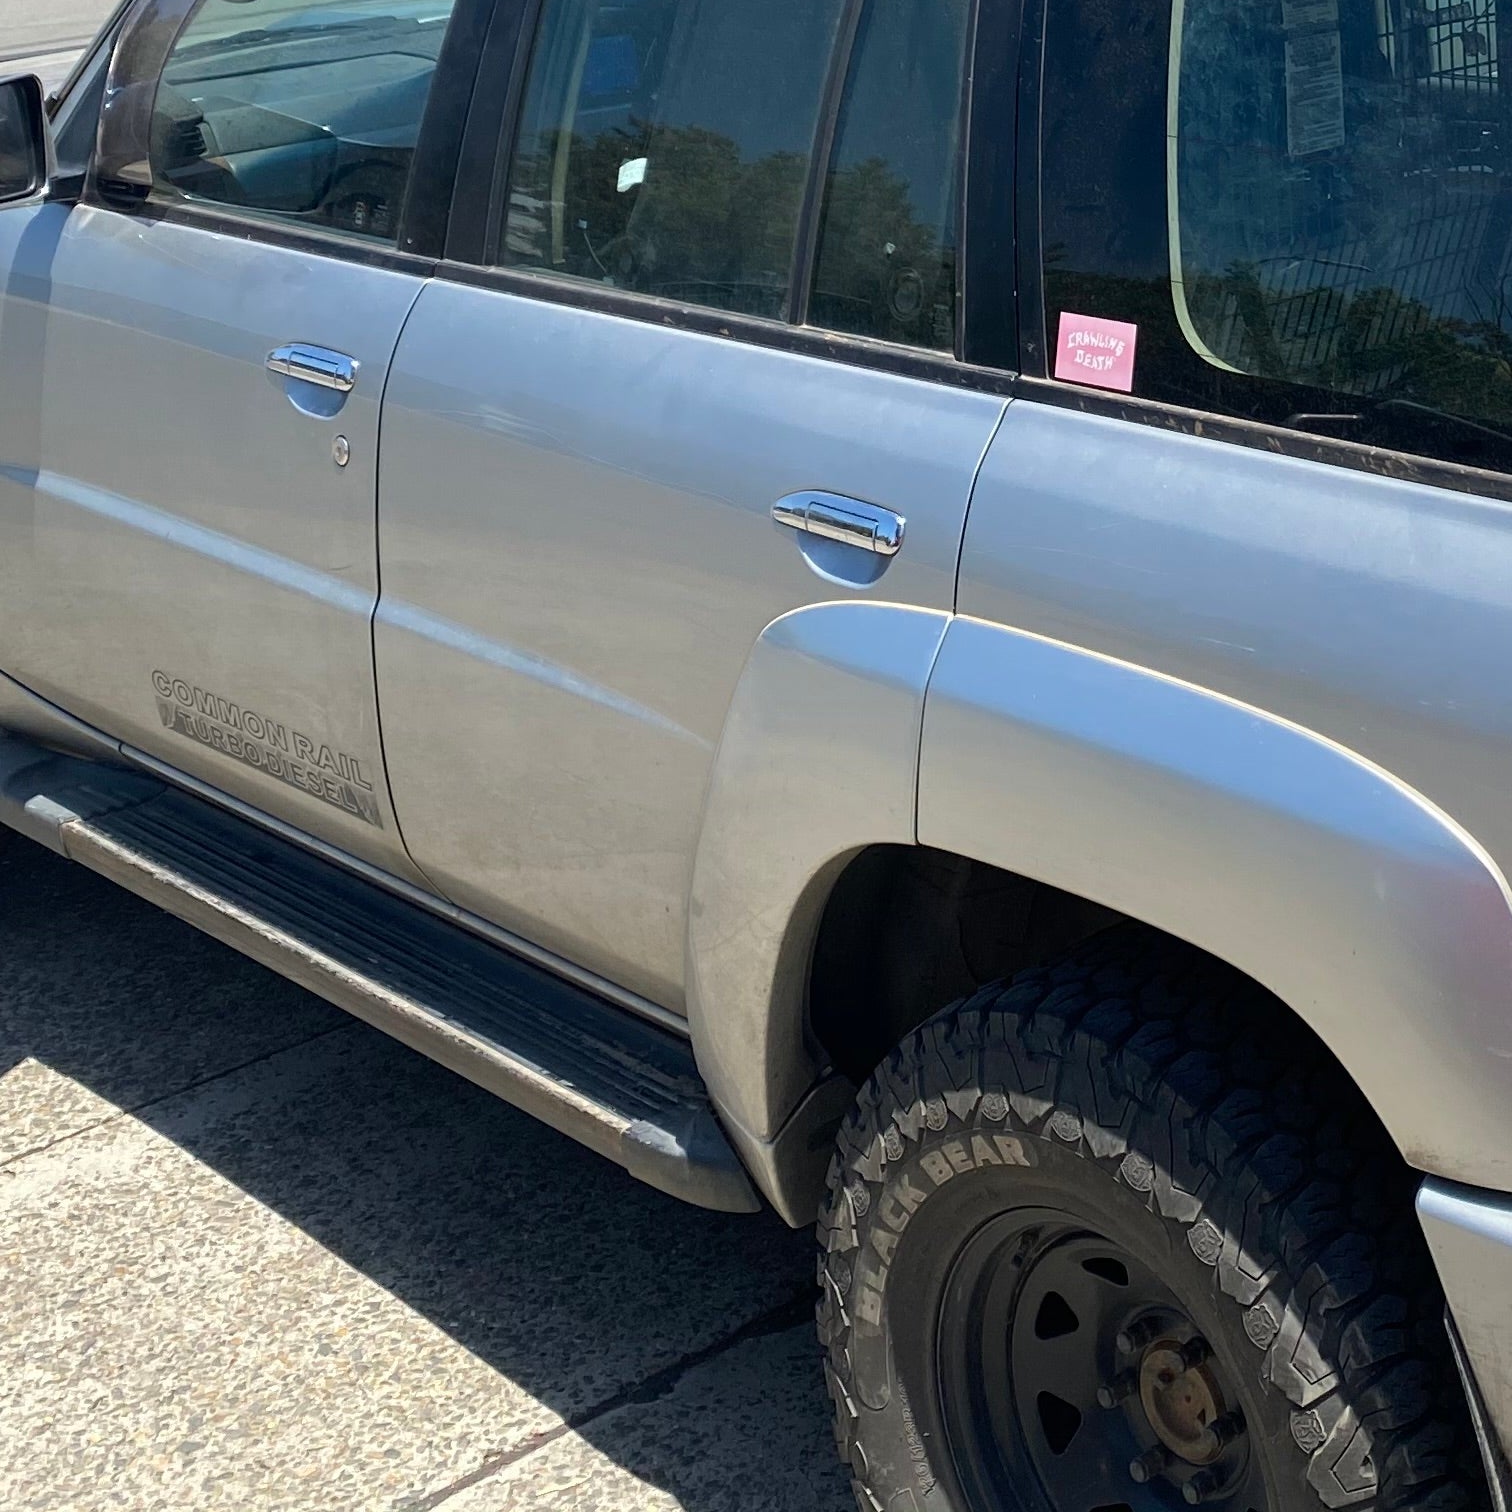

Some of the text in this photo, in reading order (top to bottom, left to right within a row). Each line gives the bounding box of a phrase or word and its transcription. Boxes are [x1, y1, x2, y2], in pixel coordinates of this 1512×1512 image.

[1066, 330, 1126, 357] CRAWLING
[1074, 348, 1115, 371] DEATH
[151, 670, 373, 792] COMMON RAIL
[178, 711, 359, 814] TURBO DIESEL
[855, 1134, 1031, 1327] BLACK BEAR
